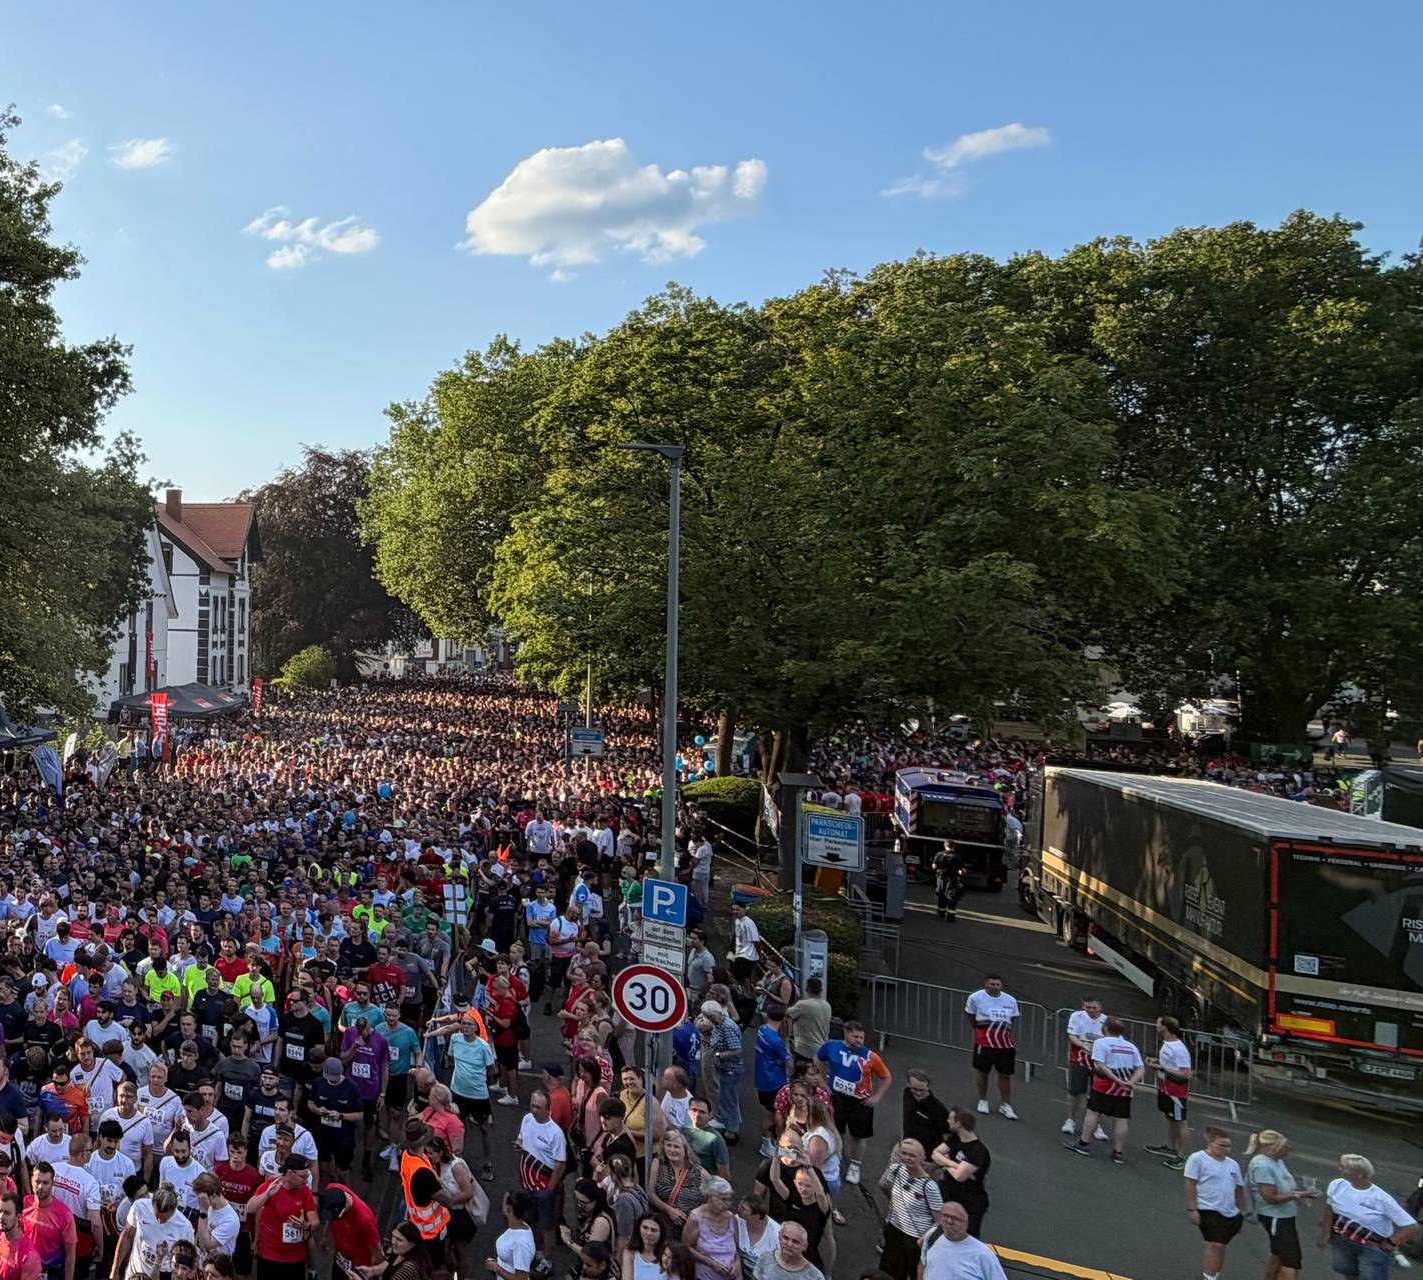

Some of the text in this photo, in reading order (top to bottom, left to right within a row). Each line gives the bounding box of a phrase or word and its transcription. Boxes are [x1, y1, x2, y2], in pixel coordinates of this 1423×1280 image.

[809, 816, 856, 830] PARKSCHEIN-
[818, 826, 849, 838] AUTOMAT
[652, 885, 676, 915] P
[1402, 917, 1423, 930] RIS
[645, 955, 681, 969] Parkschein
[657, 951, 669, 959] mit
[628, 981, 670, 1014] 30
